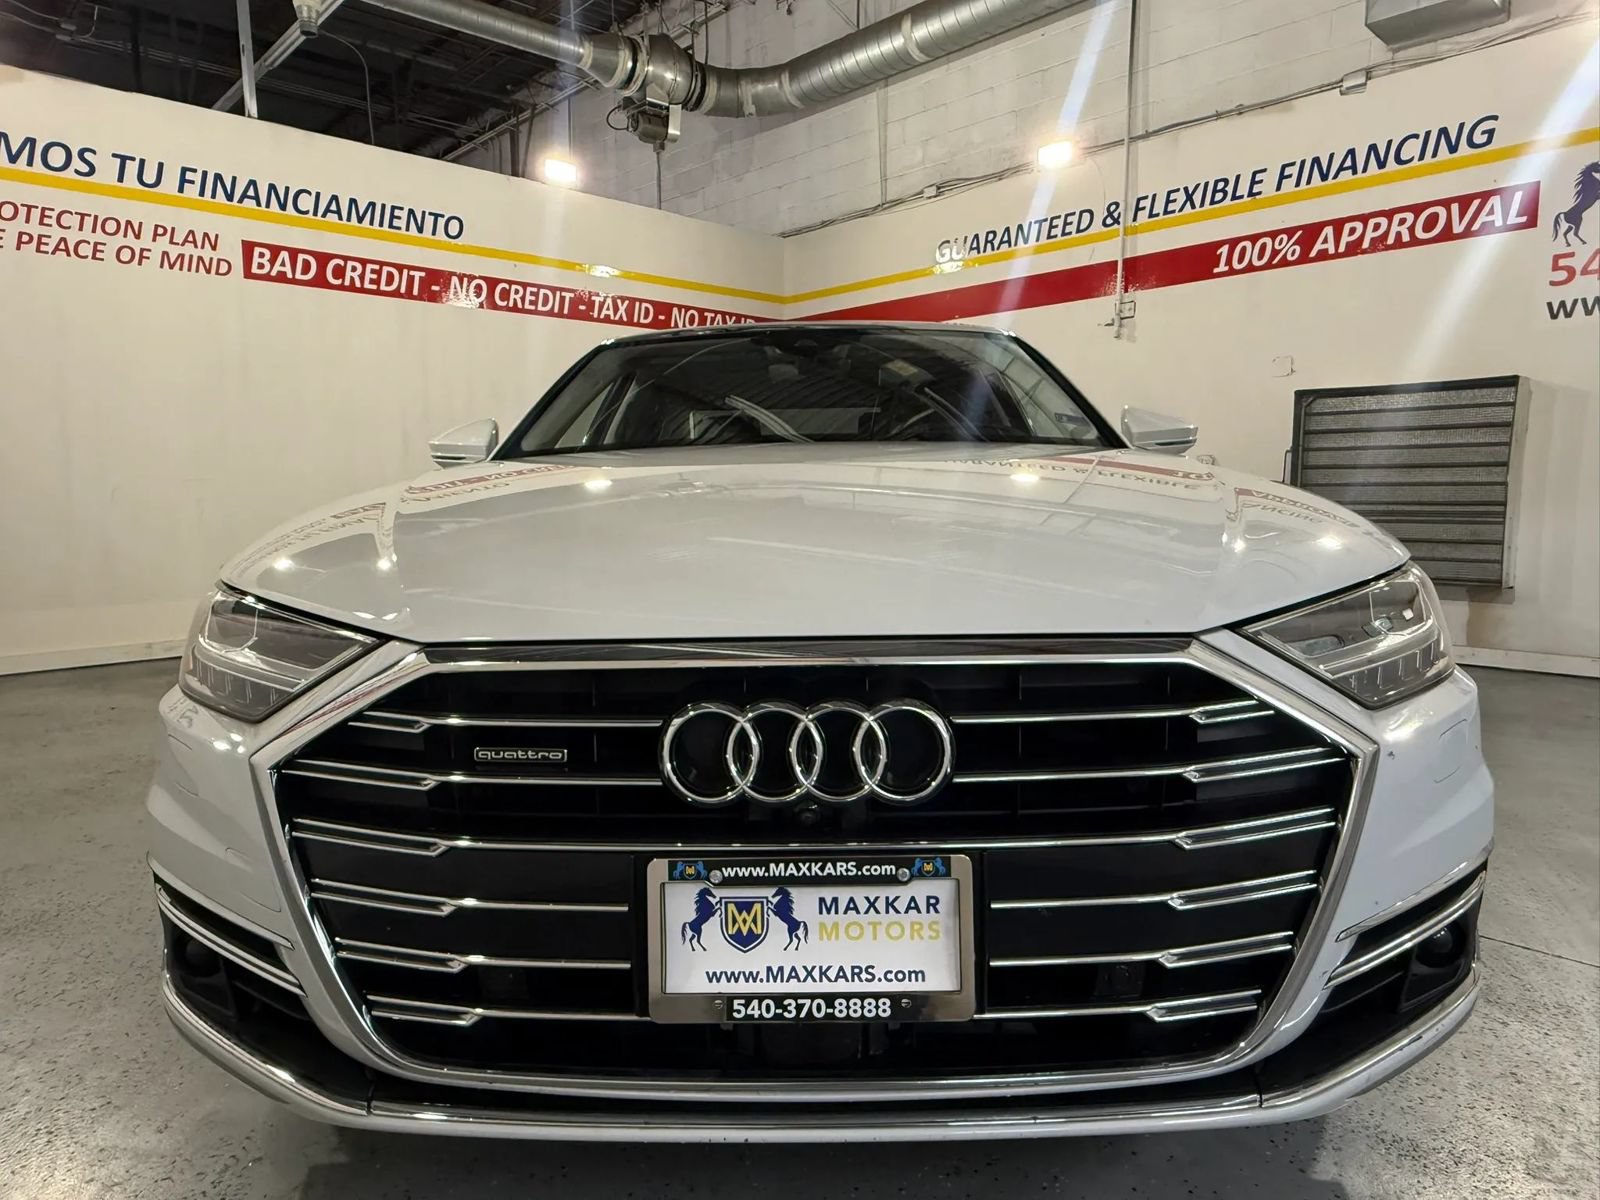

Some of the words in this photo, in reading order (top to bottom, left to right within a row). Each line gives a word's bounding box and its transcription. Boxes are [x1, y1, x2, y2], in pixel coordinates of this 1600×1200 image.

[111, 152, 165, 188] TU
[177, 165, 464, 240] FINANCIAMIENTO
[935, 208, 1095, 264] GUARANTEED
[1101, 201, 1121, 228] &
[1132, 168, 1268, 223] FLEXIBLE
[1275, 114, 1499, 192] FINANCING
[0, 201, 143, 241] OTECTION
[152, 223, 219, 252] PLAN
[1212, 230, 1303, 274] 100%
[1309, 190, 1528, 258] APPROVAL
[16, 231, 107, 261] PEACE
[115, 245, 152, 267] OF
[159, 250, 233, 276] MIND
[251, 246, 317, 280] BAD
[325, 258, 425, 296] CREDIT
[449, 275, 487, 304] NO
[494, 282, 575, 315] CREDIT
[591, 296, 630, 322] TAX
[633, 301, 654, 324] ID
[670, 307, 699, 328] NO
[478, 750, 562, 760] quattro
[721, 861, 896, 878] www.MAXKARS.com
[818, 895, 941, 915] MAXKAR
[818, 920, 942, 942] MOTORS
[705, 964, 926, 984] www.MAXKARS.com
[732, 998, 892, 1019] 540-370-8888
